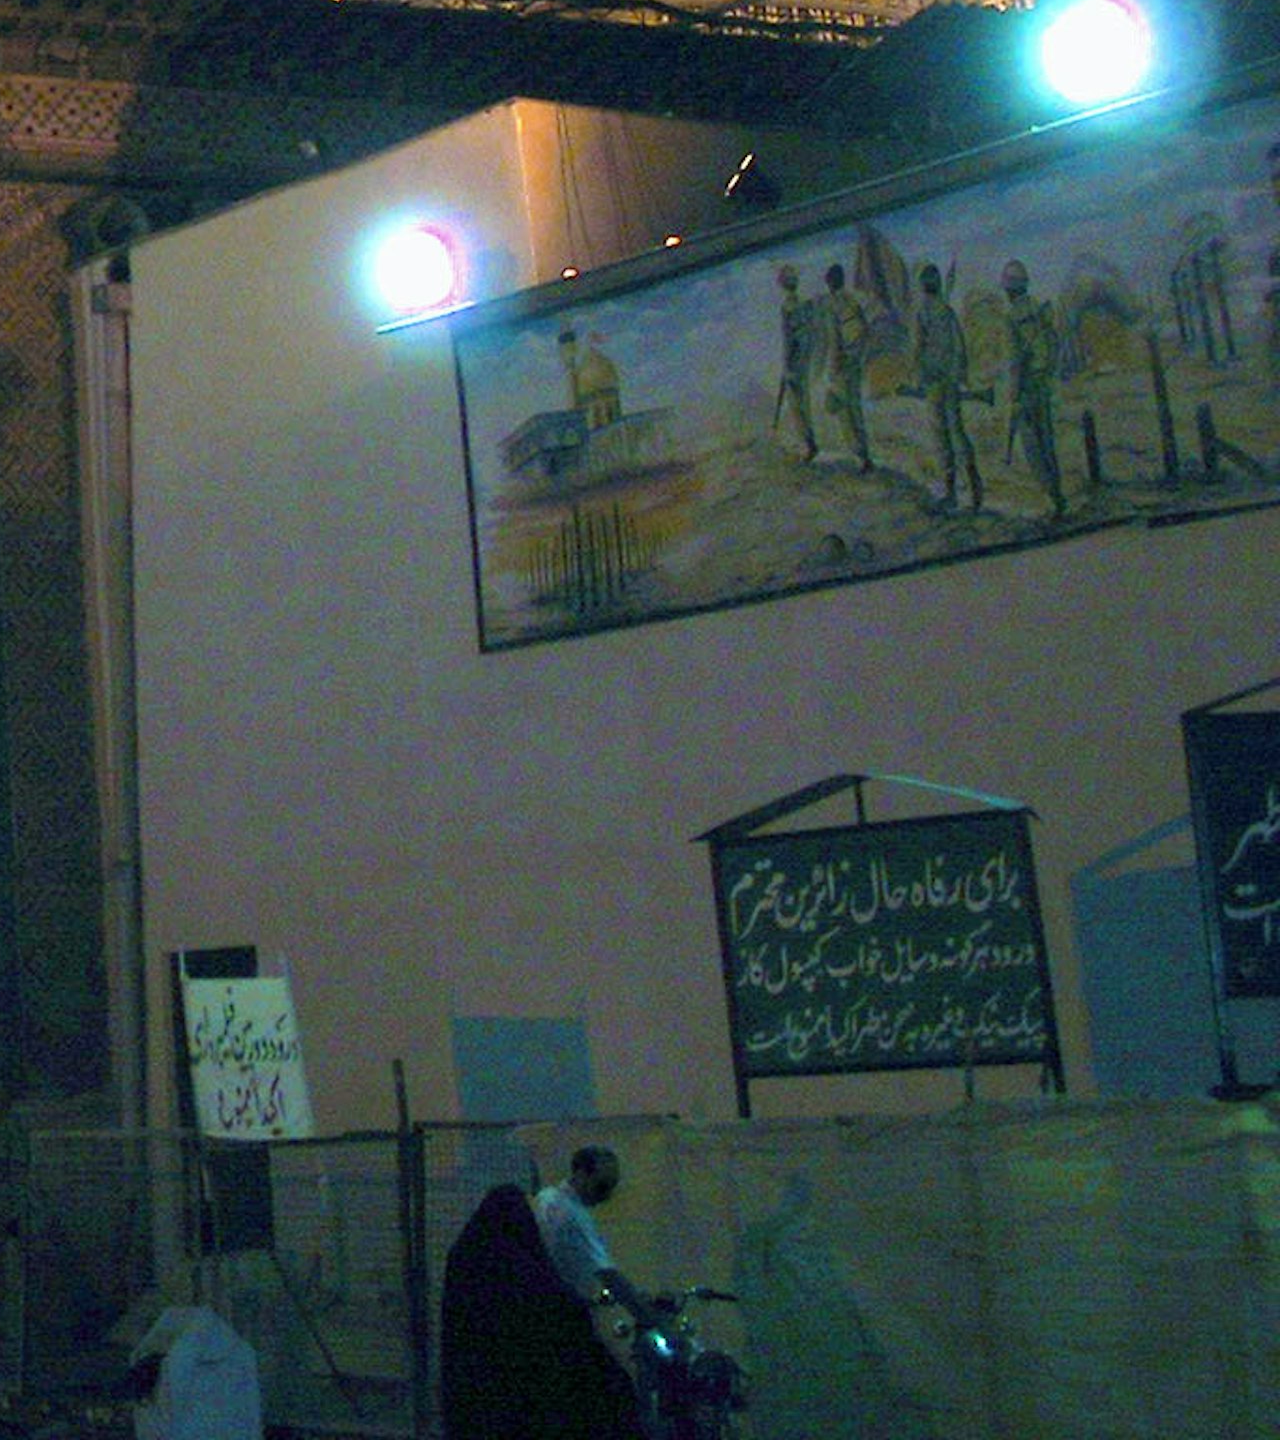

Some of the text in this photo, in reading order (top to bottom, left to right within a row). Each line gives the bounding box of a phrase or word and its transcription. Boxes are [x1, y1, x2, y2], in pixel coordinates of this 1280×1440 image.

[729, 857, 789, 941] محترم
[849, 856, 910, 926] حال
[910, 853, 964, 907] رفاه
[965, 850, 1023, 913] برای
